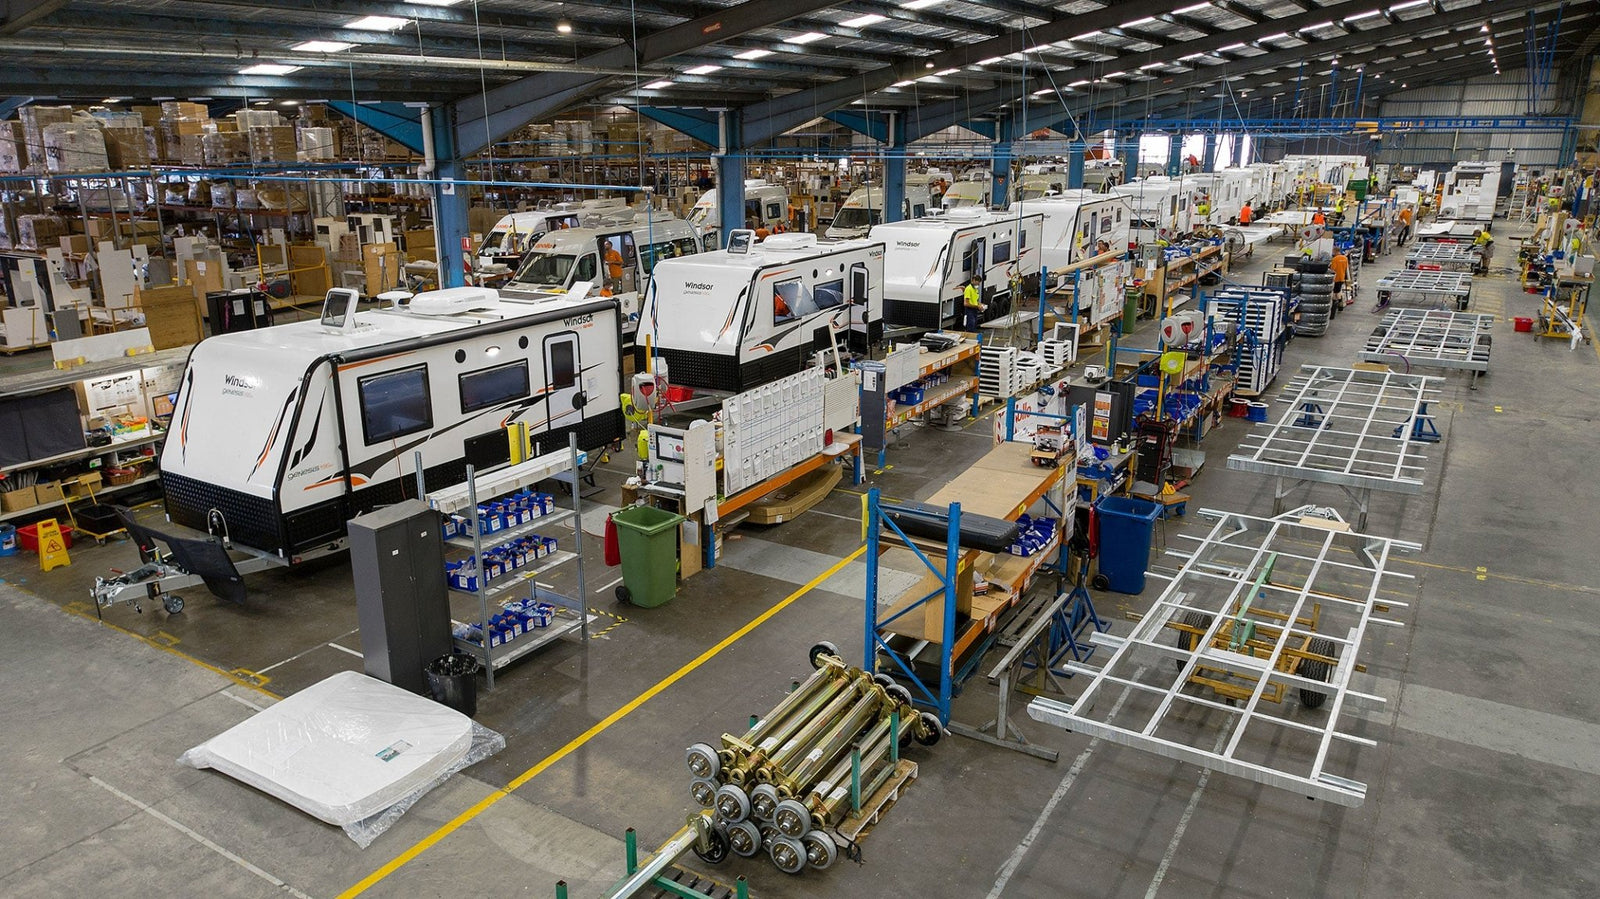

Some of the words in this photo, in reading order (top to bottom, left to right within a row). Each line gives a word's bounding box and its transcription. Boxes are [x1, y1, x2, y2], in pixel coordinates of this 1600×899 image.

[896, 240, 920, 248] Windsor
[684, 281, 714, 291] Windsor
[563, 313, 594, 328] Windsor
[224, 374, 256, 391] Winds
